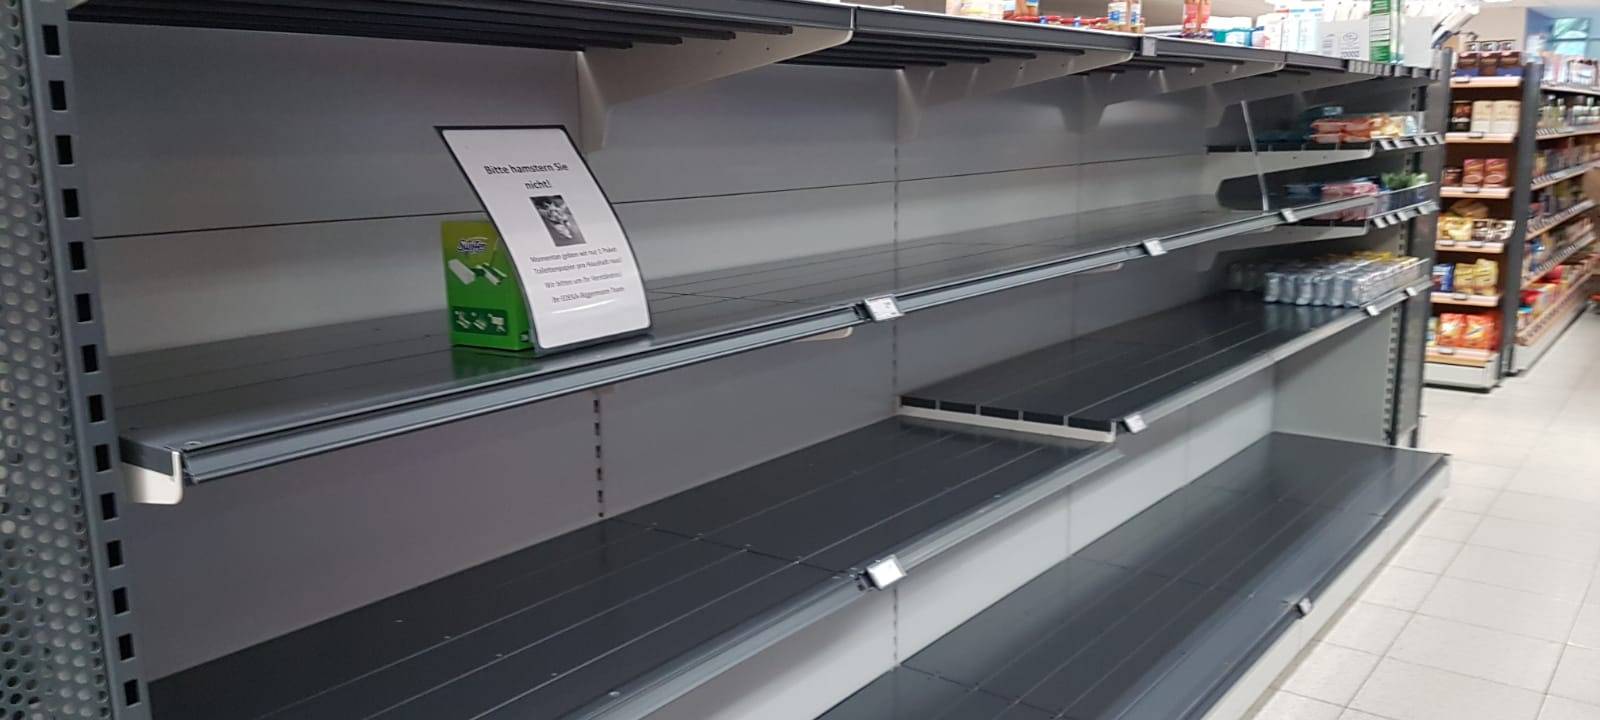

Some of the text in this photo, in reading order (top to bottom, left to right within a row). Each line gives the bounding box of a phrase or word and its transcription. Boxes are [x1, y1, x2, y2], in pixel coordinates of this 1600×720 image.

[483, 162, 569, 175] Bitte hamstern Sie
[524, 179, 552, 190] nicht!
